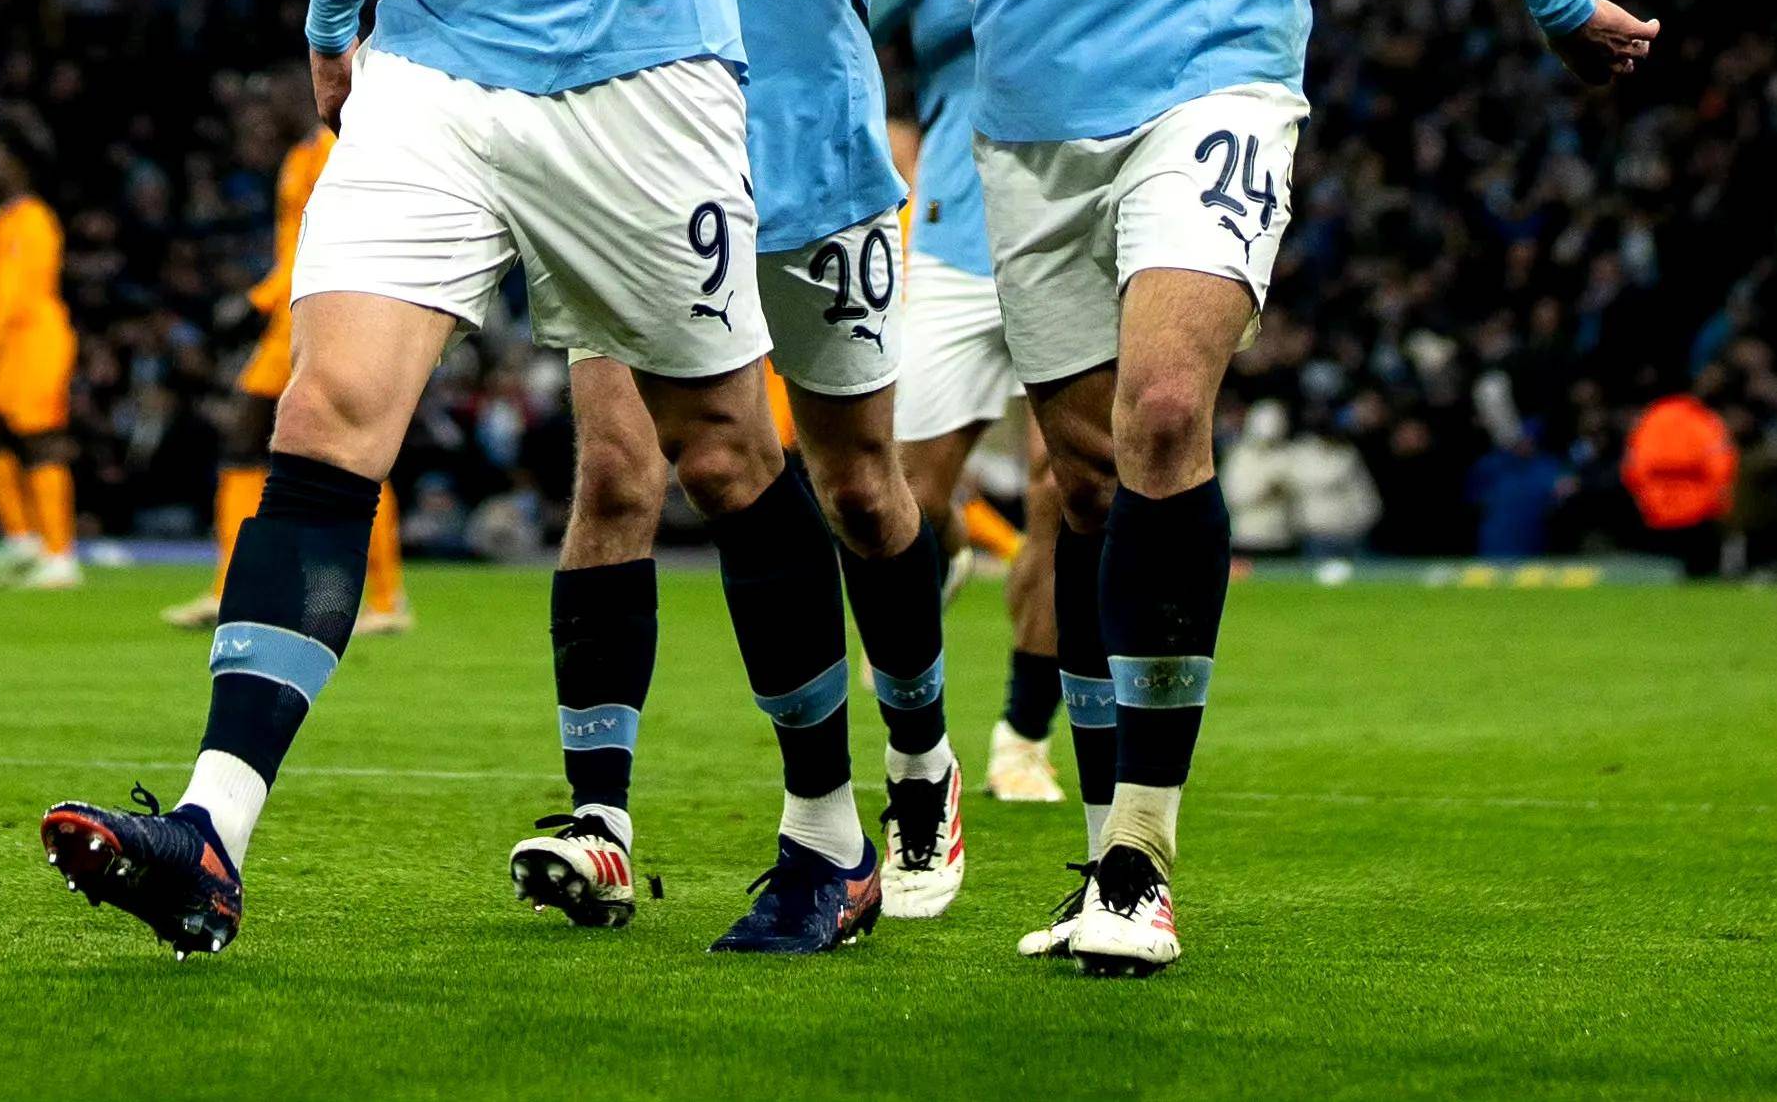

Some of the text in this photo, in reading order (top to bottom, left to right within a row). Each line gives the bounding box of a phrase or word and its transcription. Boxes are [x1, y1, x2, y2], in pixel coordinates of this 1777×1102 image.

[1195, 129, 1277, 231] 24
[687, 200, 730, 296] 9
[808, 227, 894, 325] 20
